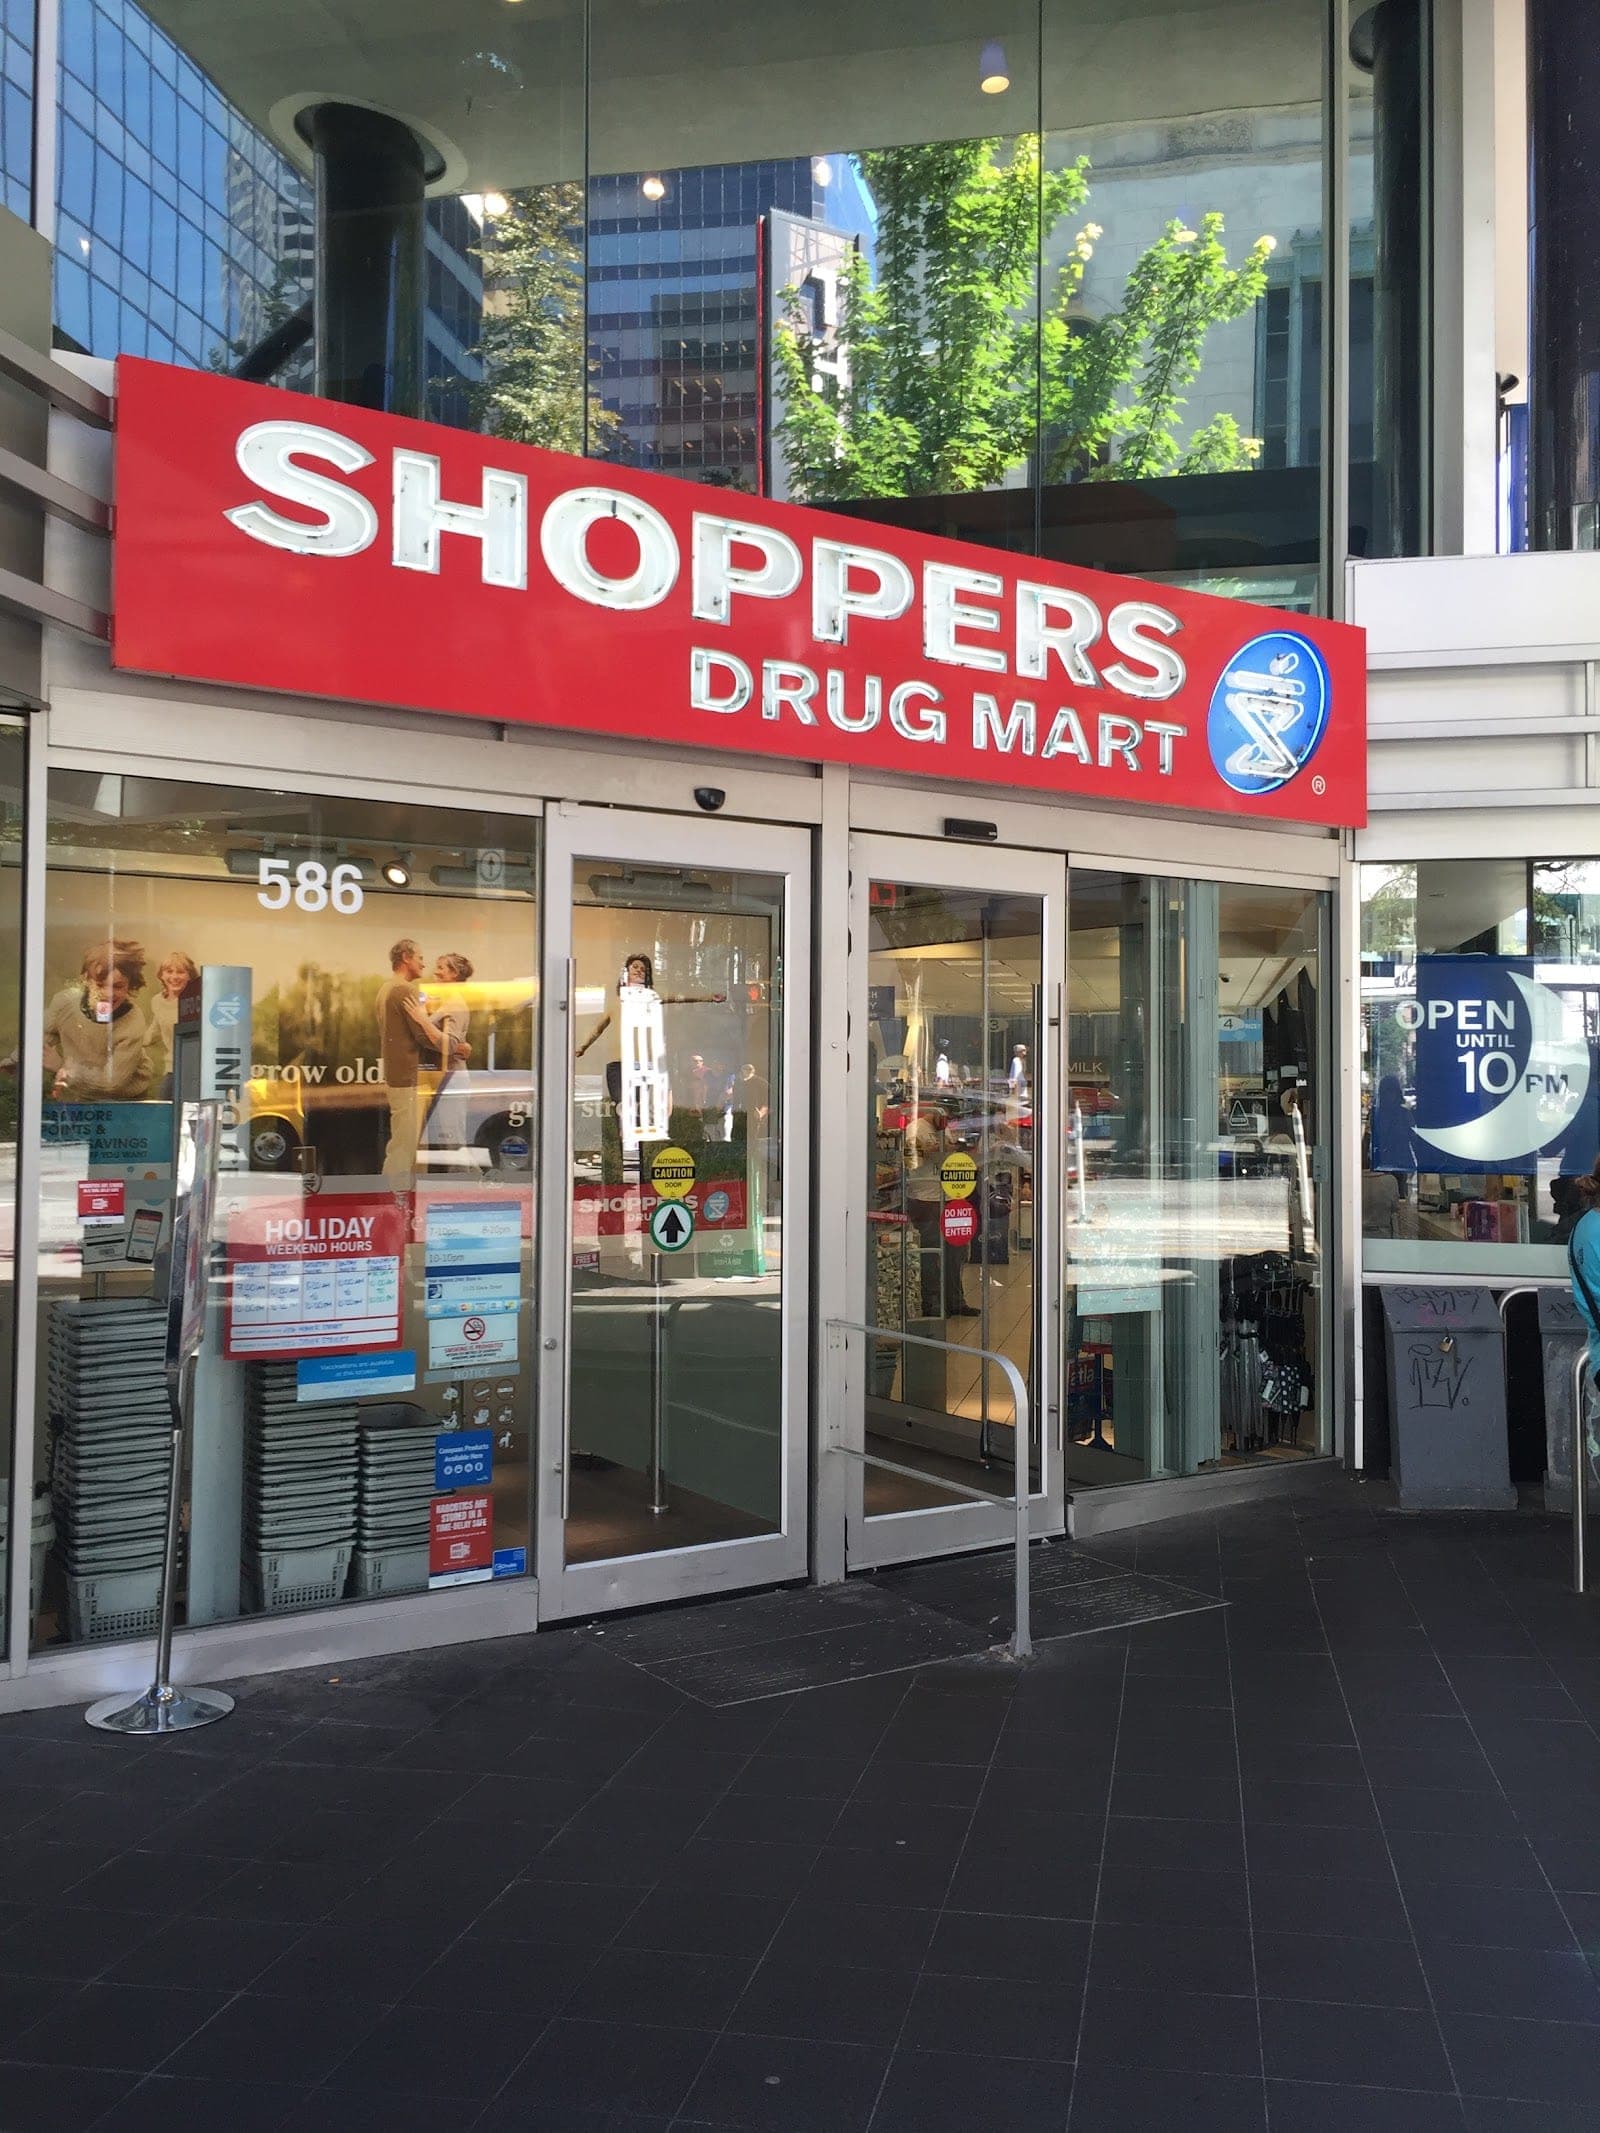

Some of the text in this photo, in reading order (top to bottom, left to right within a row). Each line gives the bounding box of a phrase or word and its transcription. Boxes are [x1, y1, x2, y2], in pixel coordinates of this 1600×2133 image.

[222, 420, 1187, 701] SHOPPERS
[690, 646, 1187, 777] DRUG MART
[256, 858, 365, 915] 586
[1395, 1000, 1516, 1031] OPEN
[1456, 1034, 1516, 1048] UNTIL
[335, 1057, 386, 1084] old
[1457, 1051, 1569, 1094] 10 PM
[656, 1157, 691, 1165] AUTOMATIC
[654, 1167, 693, 1179] CAUTION
[943, 1170, 975, 1180] CAUTION
[578, 1195, 699, 1213] SHOPPS
[628, 1212, 652, 1222] DRU
[944, 1208, 973, 1217] DO NOT
[265, 1217, 375, 1242] HOLIDAY
[945, 1227, 973, 1237] ENTER
[266, 1240, 373, 1255] WEEKEND HOURS
[454, 1367, 492, 1379] NOTICE
